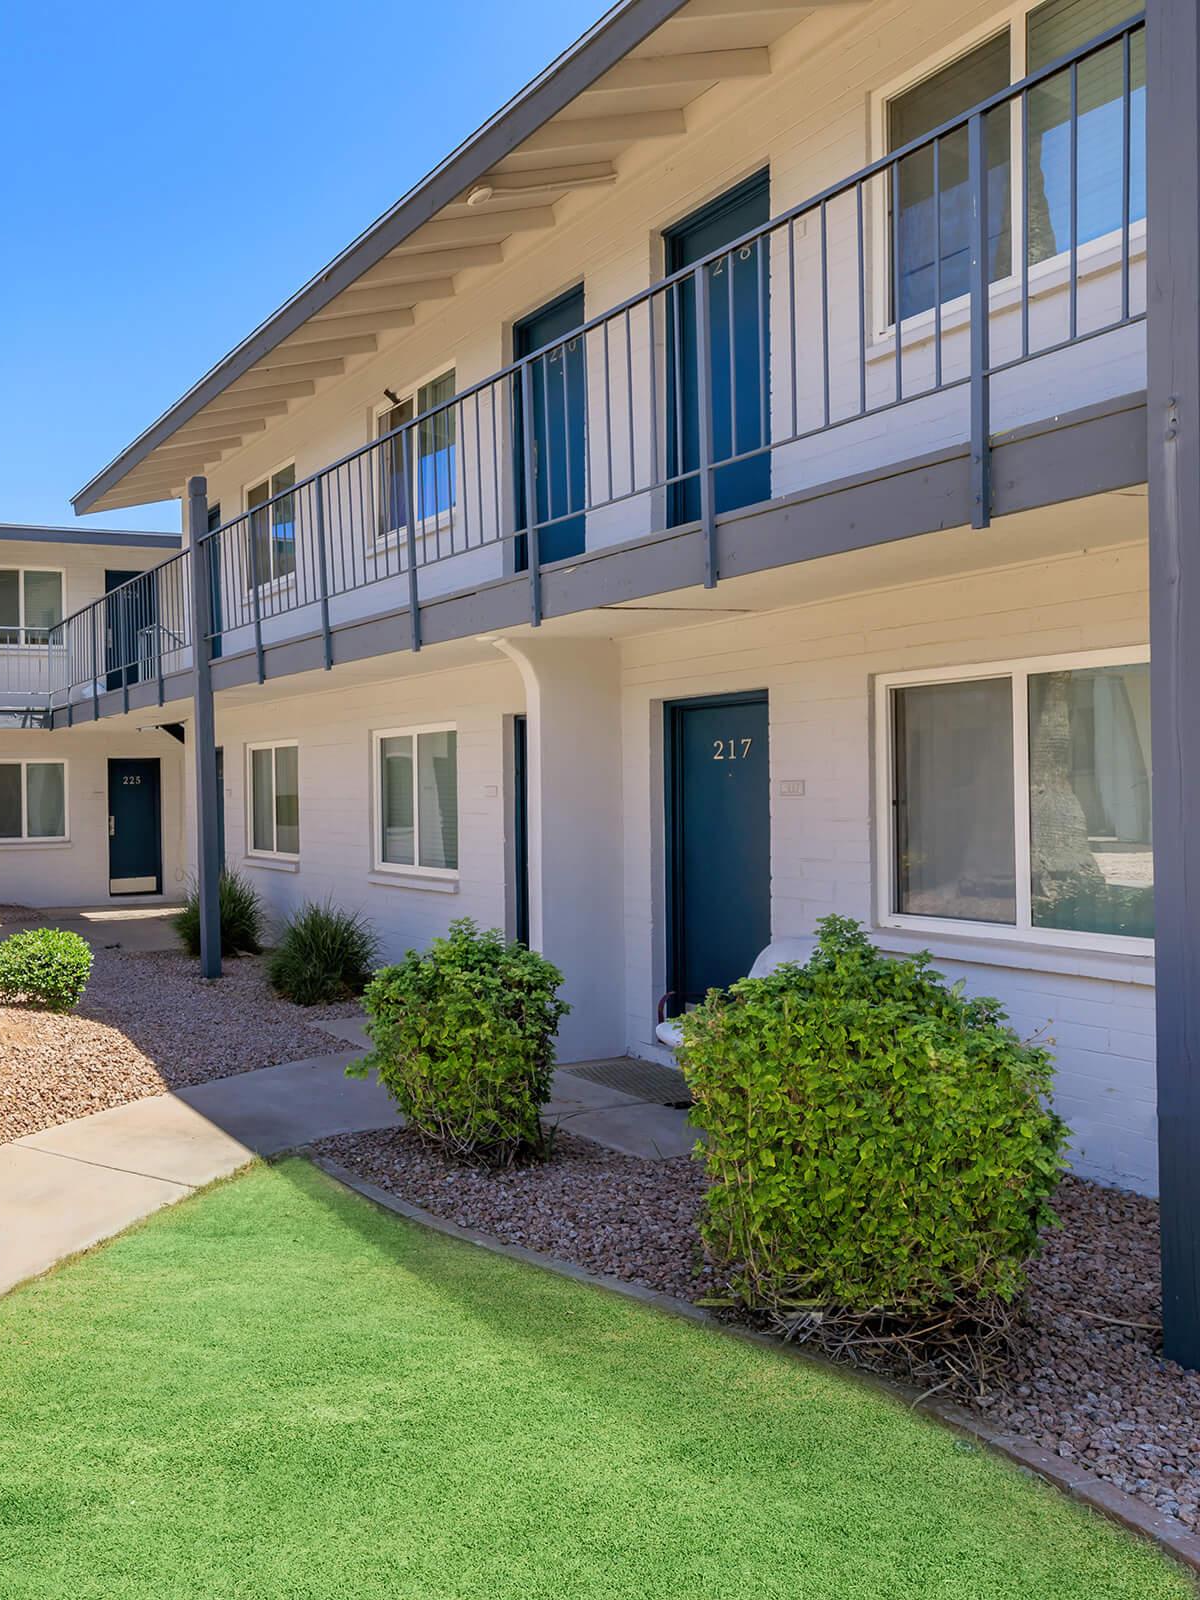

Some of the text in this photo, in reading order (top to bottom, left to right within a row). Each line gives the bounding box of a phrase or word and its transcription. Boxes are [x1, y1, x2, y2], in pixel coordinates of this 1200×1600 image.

[712, 246, 751, 276] 28
[713, 738, 752, 760] 217
[122, 775, 141, 785] 225
